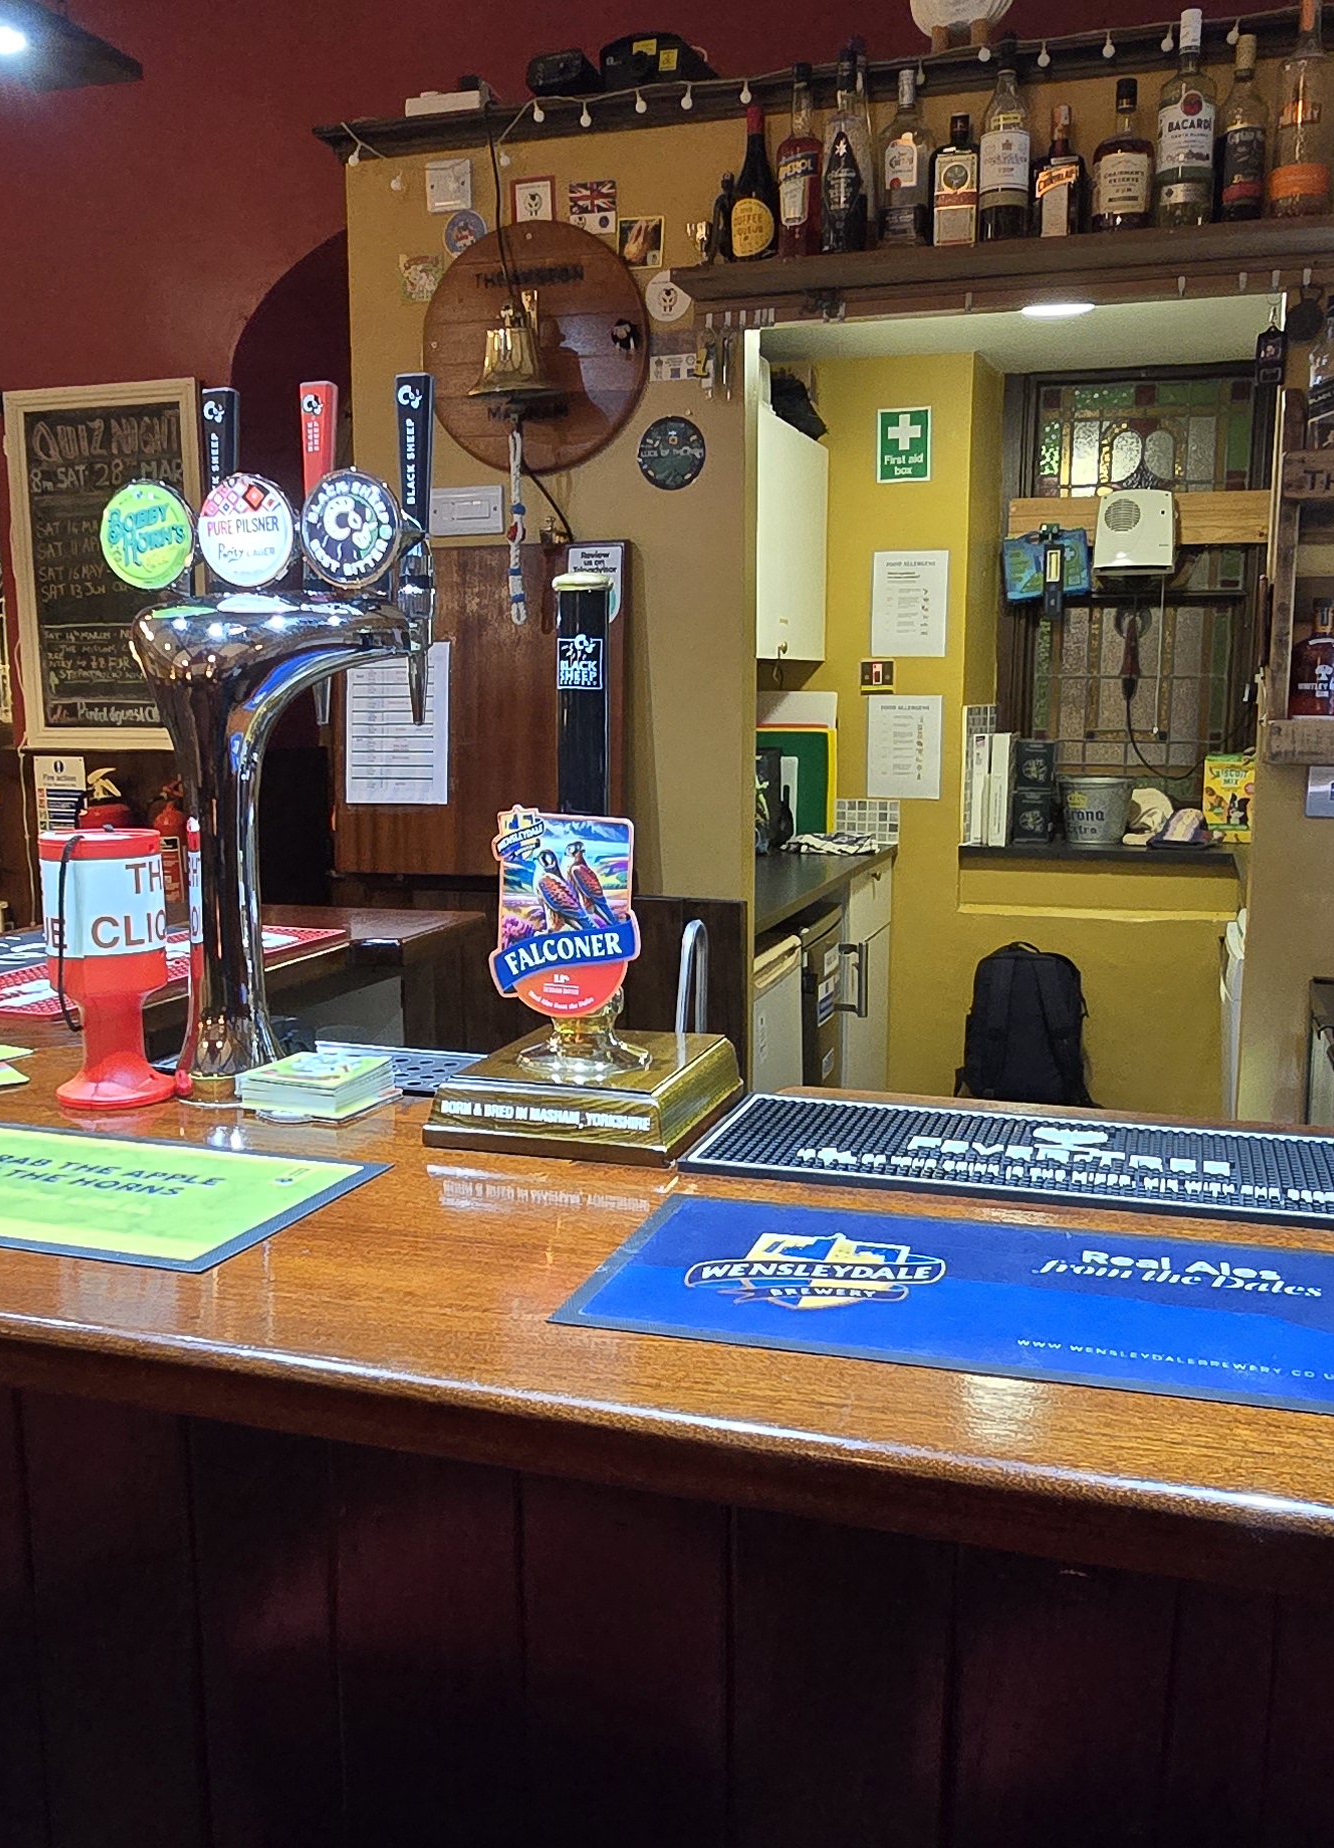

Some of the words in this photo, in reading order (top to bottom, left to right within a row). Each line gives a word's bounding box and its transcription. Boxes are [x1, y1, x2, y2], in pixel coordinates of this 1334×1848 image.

[31, 418, 109, 464] QUIZ
[210, 432, 220, 466] SHEEP
[406, 418, 417, 461] SHEEP
[884, 455, 906, 465] First
[908, 453, 924, 463] aid
[894, 466, 913, 476] box
[406, 464, 417, 505] BLACK
[307, 481, 349, 524] BLACK
[351, 481, 390, 525] SHEEP
[207, 522, 233, 538] PURE
[235, 515, 280, 535] PILSNER
[309, 538, 341, 573] BEST
[343, 538, 389, 577] BITTER
[580, 551, 610, 559] Review
[560, 660, 598, 672] BLACK
[560, 671, 598, 681] SHEEP
[43, 774, 55, 782] Fire
[1066, 808, 1105, 822] rona
[504, 932, 623, 975] FALCONER
[441, 1100, 472, 1115] BORN
[473, 1103, 483, 1117] &
[484, 1104, 515, 1120] BRED
[516, 1106, 528, 1120] IN
[529, 1107, 584, 1129] MASHAM,
[585, 1112, 651, 1132] YORKSHIRE
[5, 1169, 68, 1185] THE
[69, 1176, 186, 1197] HORNS
[58, 1161, 121, 1177] THE
[122, 1168, 227, 1188] APPLE
[701, 1262, 933, 1281] WENSLEYDALE
[1031, 1258, 1133, 1279] from
[1141, 1269, 1202, 1286] the
[1211, 1274, 1323, 1298] Dales
[1081, 1250, 1171, 1271] Real
[1185, 1261, 1281, 1281] Ales
[769, 1286, 877, 1298] BREWERY
